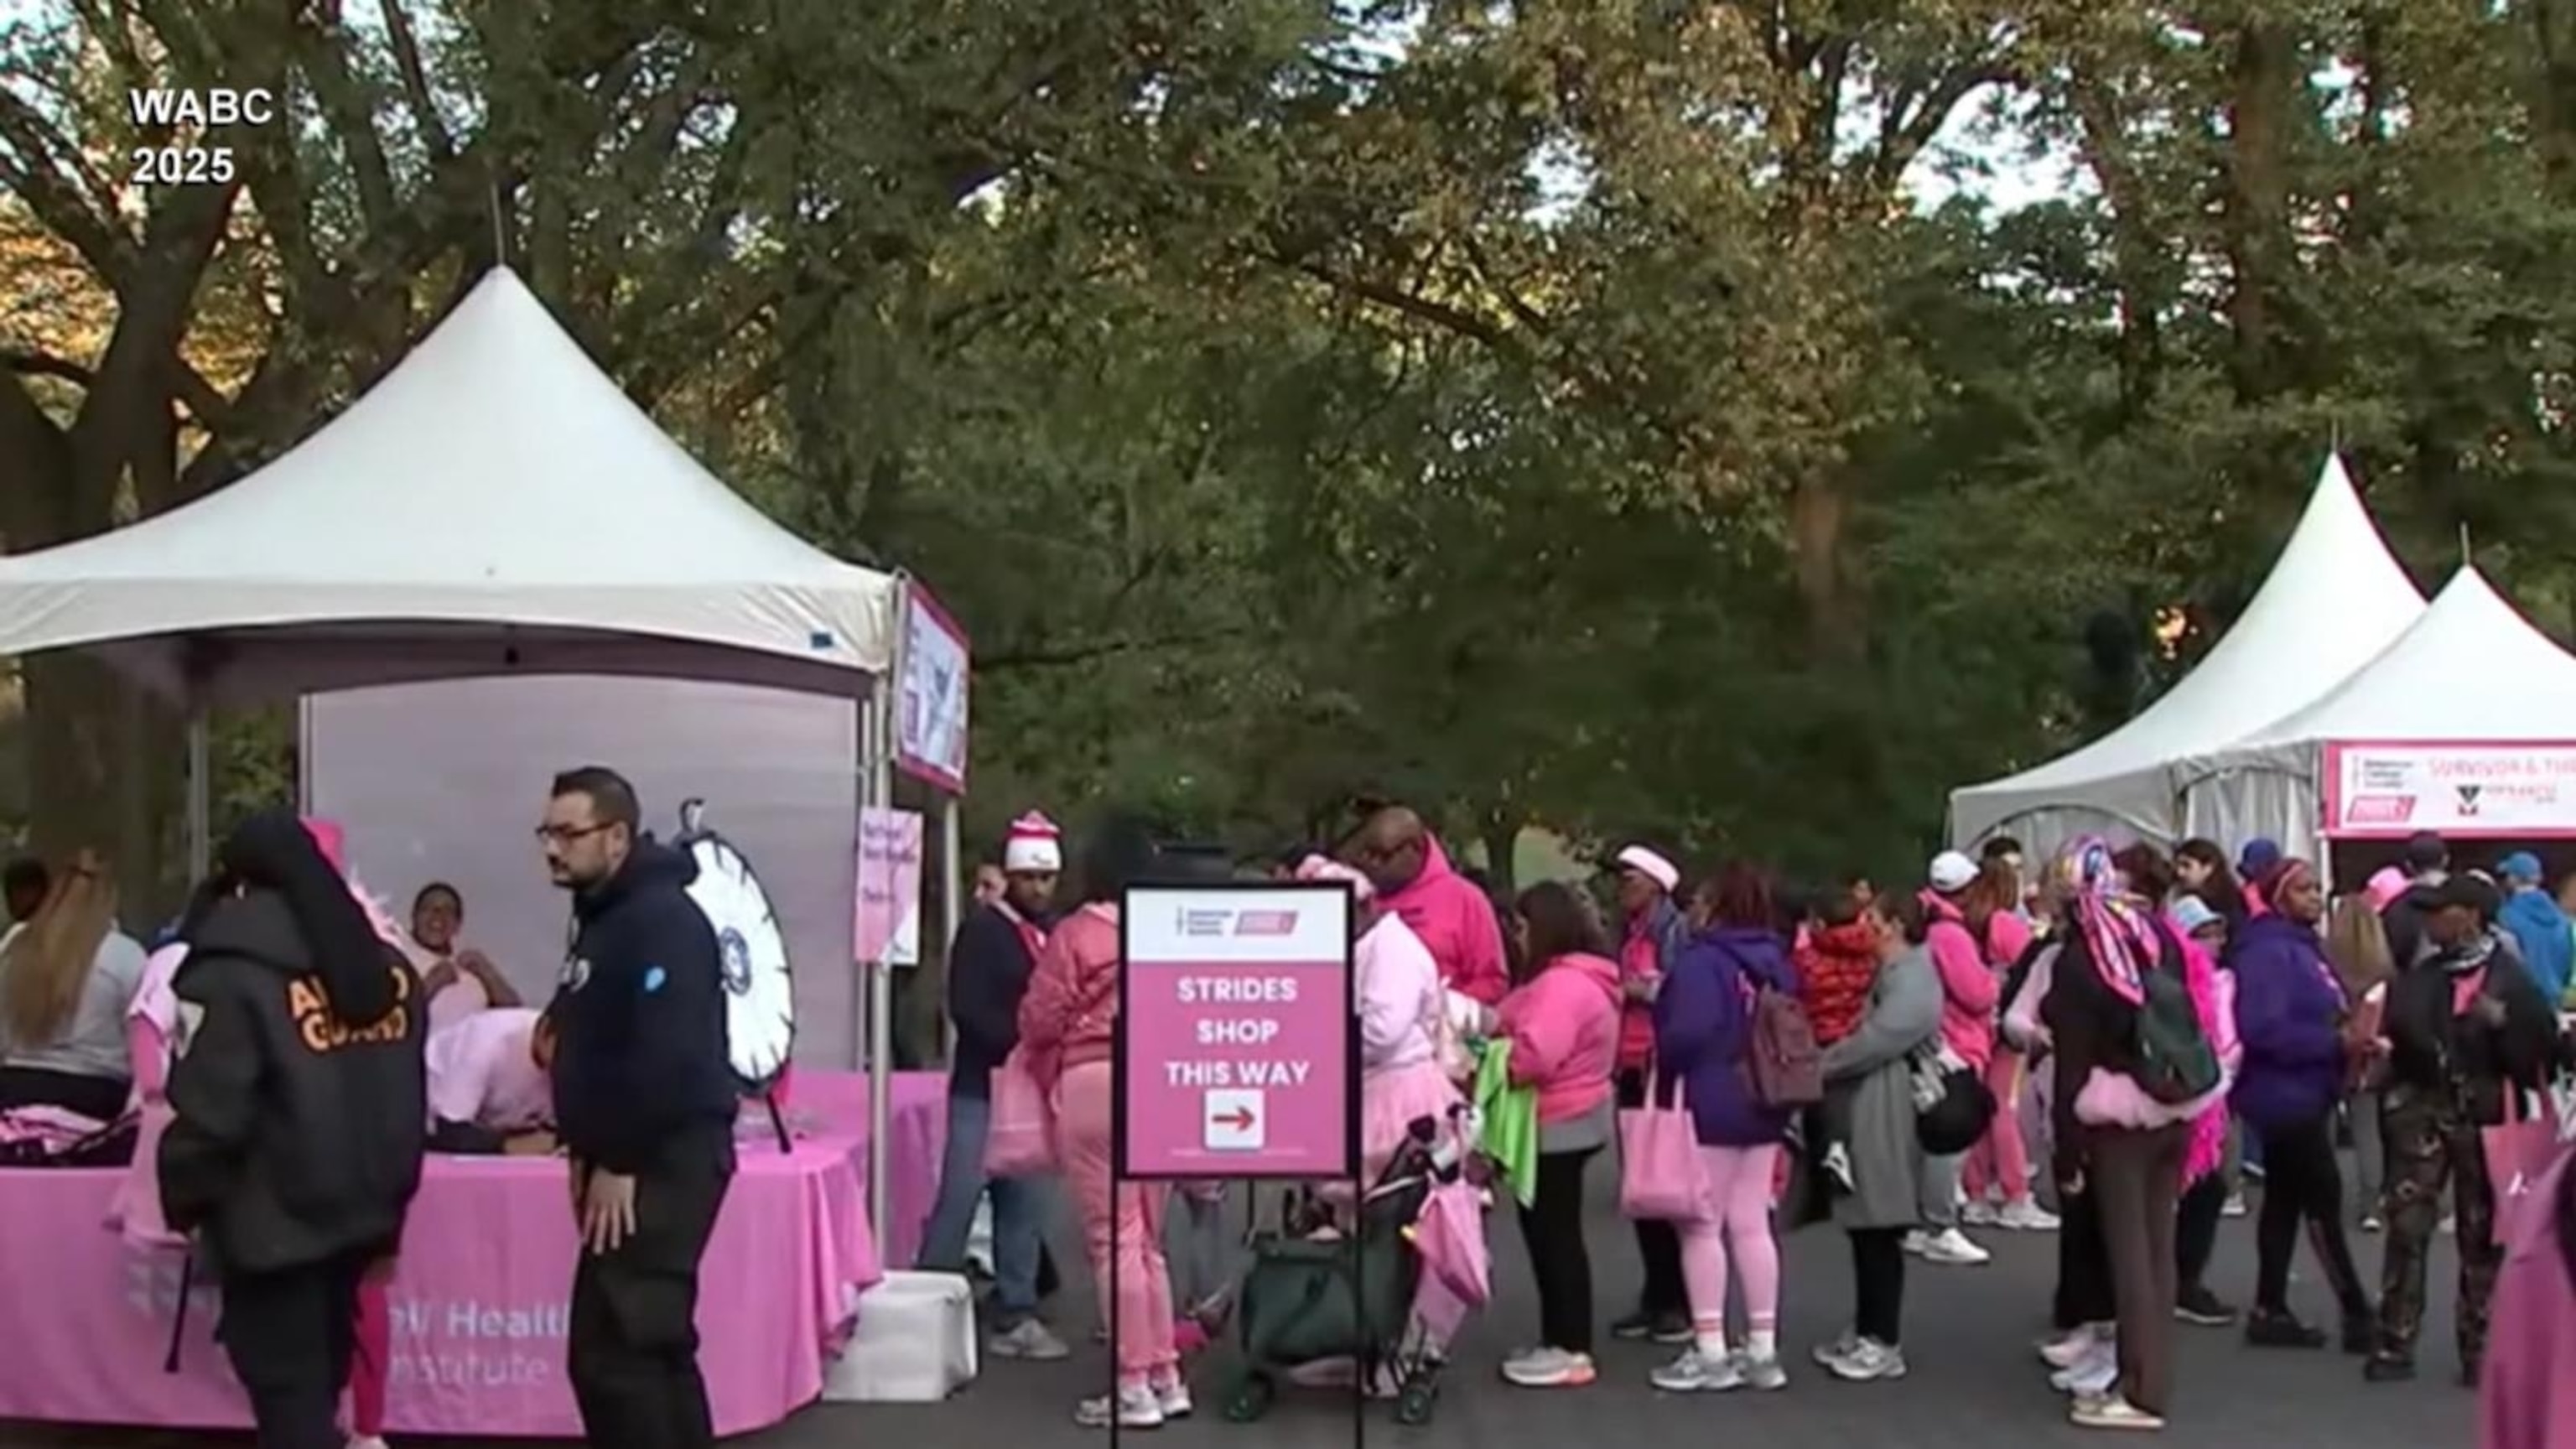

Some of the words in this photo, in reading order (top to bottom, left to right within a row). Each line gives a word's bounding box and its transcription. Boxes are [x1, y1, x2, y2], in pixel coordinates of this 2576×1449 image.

[1176, 976, 1298, 1002] STRIDES
[1196, 1019, 1280, 1044] SHOP
[1164, 1061, 1231, 1086] THIS
[1238, 1061, 1311, 1086] WAY
[448, 1301, 571, 1337] Healt
